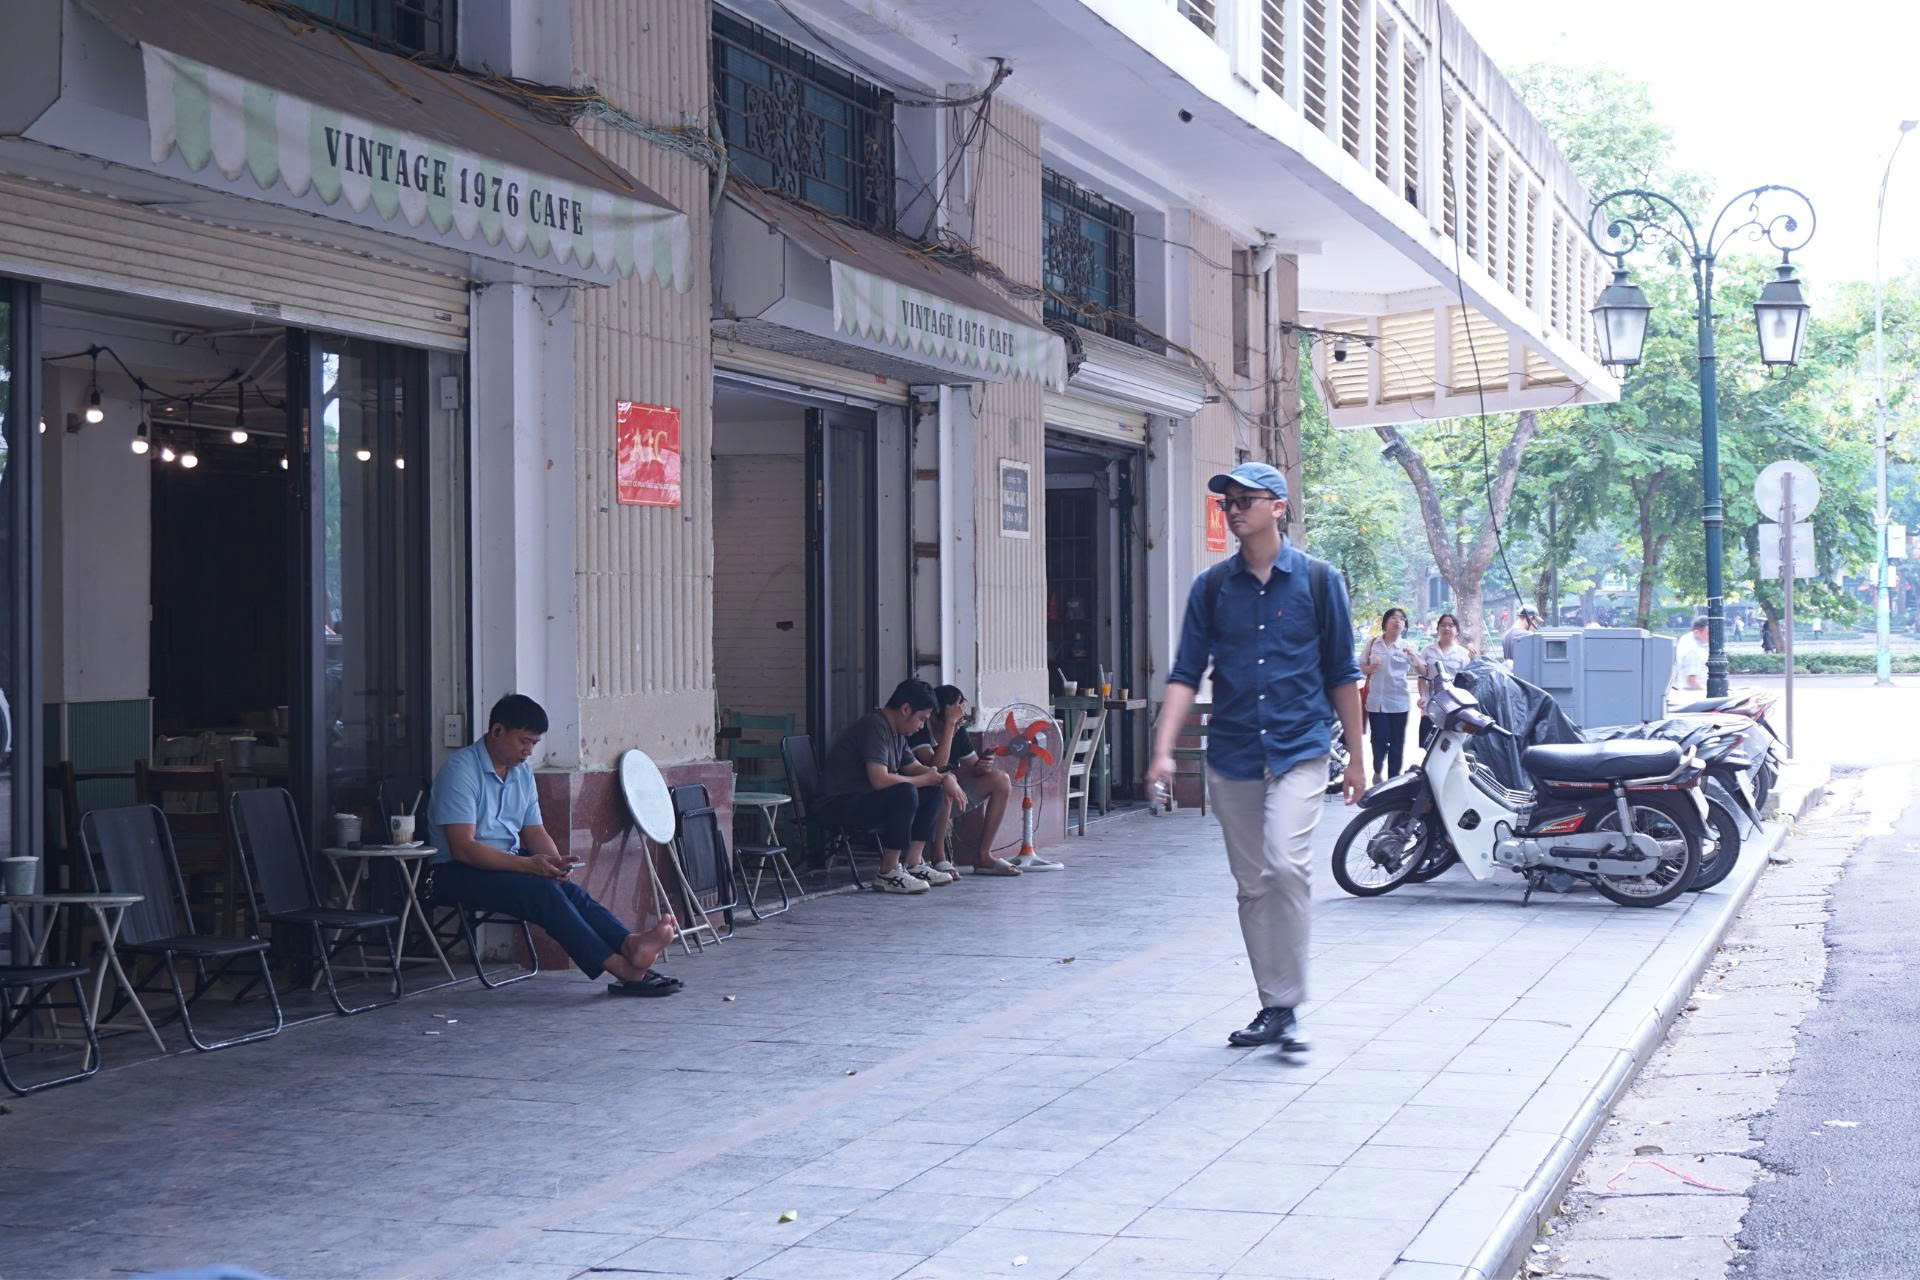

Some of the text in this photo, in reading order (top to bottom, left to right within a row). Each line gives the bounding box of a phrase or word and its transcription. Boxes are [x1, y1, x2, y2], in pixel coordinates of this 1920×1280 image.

[324, 126, 584, 236] VINTAGE 1976 CAFE
[902, 300, 1014, 358] VINTAGE 1976 CAFE
